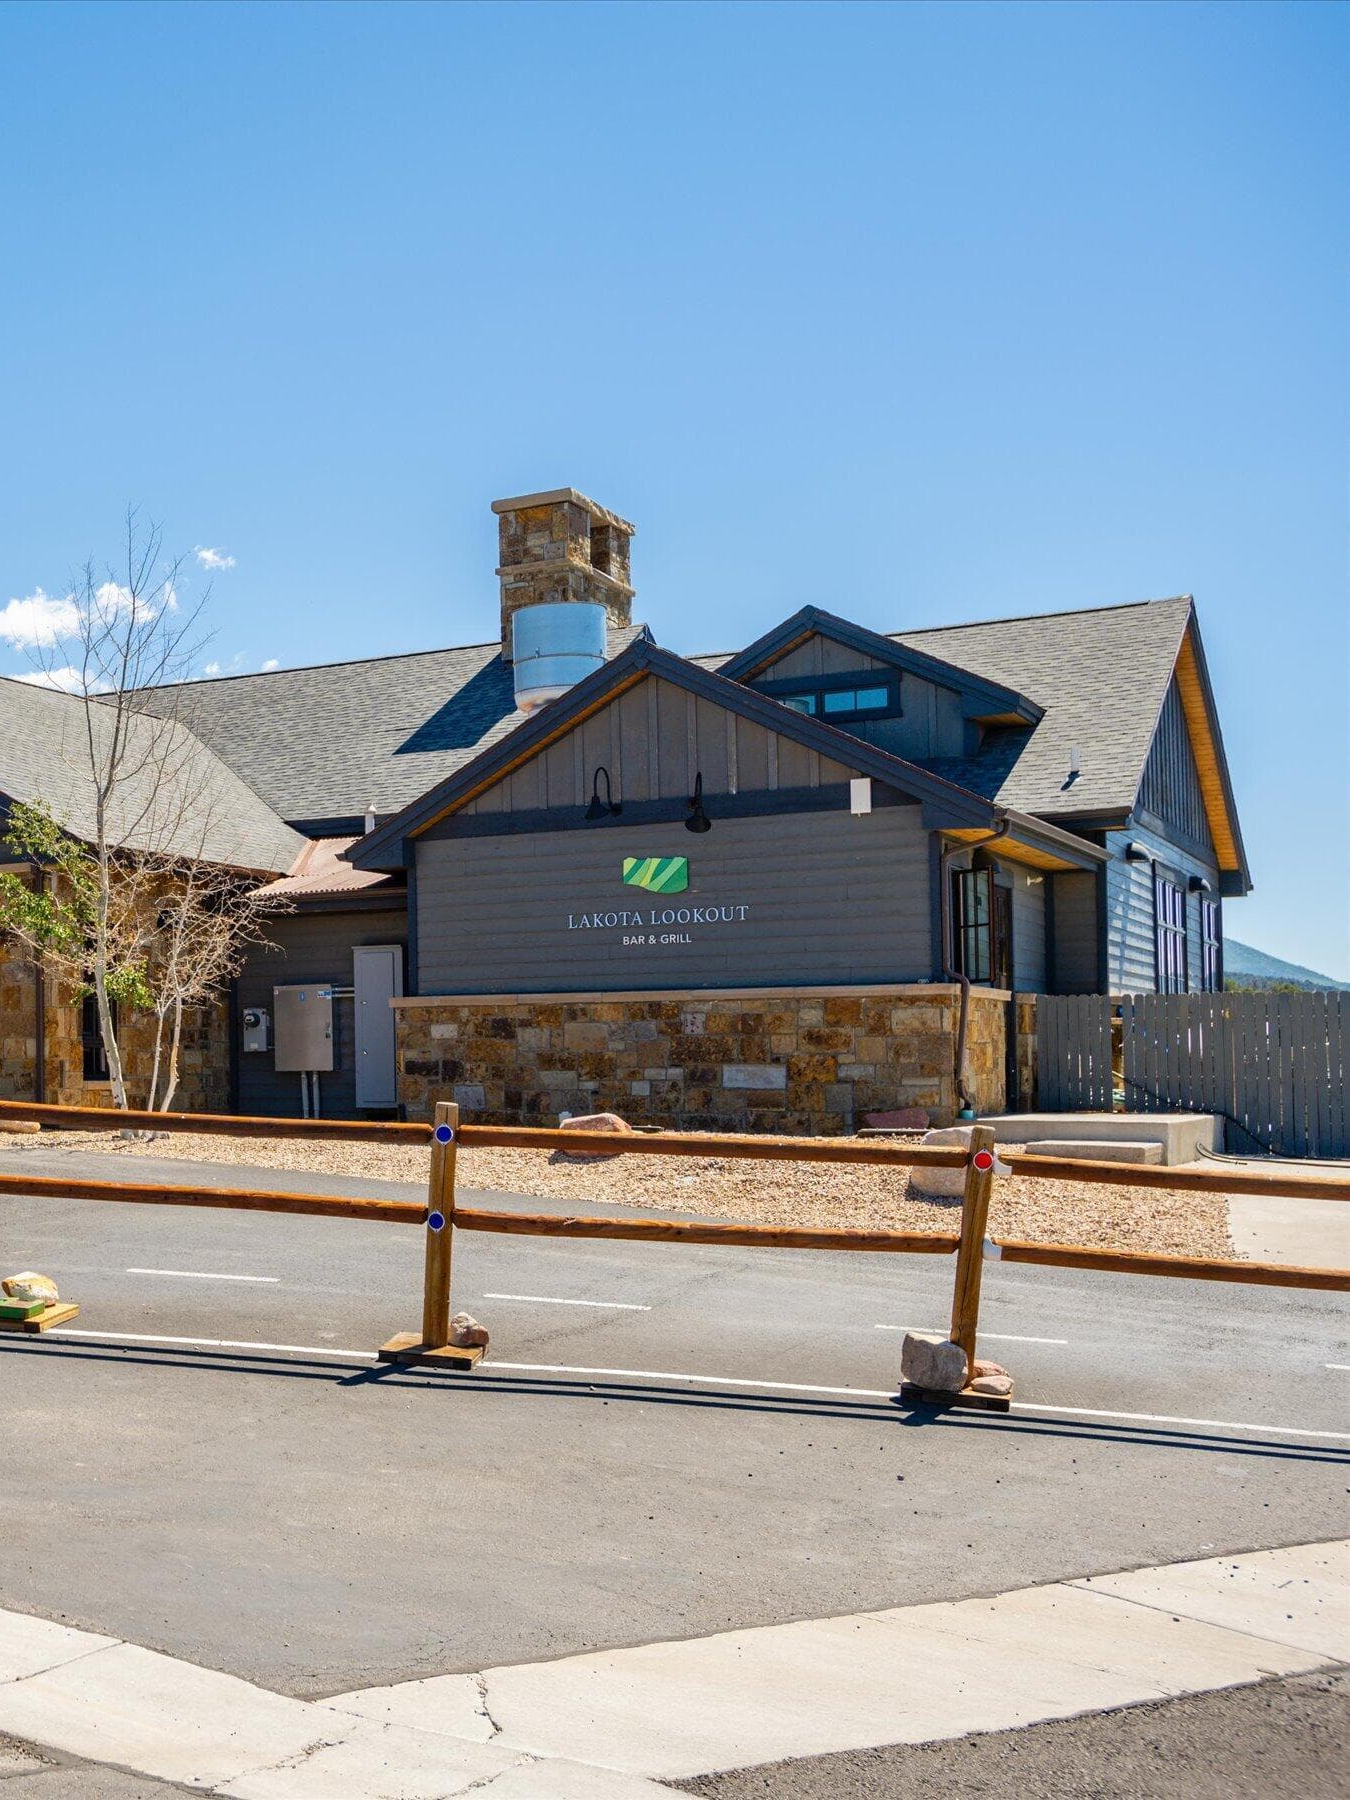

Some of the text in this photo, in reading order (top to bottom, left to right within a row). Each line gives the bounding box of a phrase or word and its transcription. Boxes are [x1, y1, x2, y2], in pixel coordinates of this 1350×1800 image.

[568, 905, 749, 929] LAKOTA LOOKOUT
[623, 934, 692, 945] BAR & GRILL
